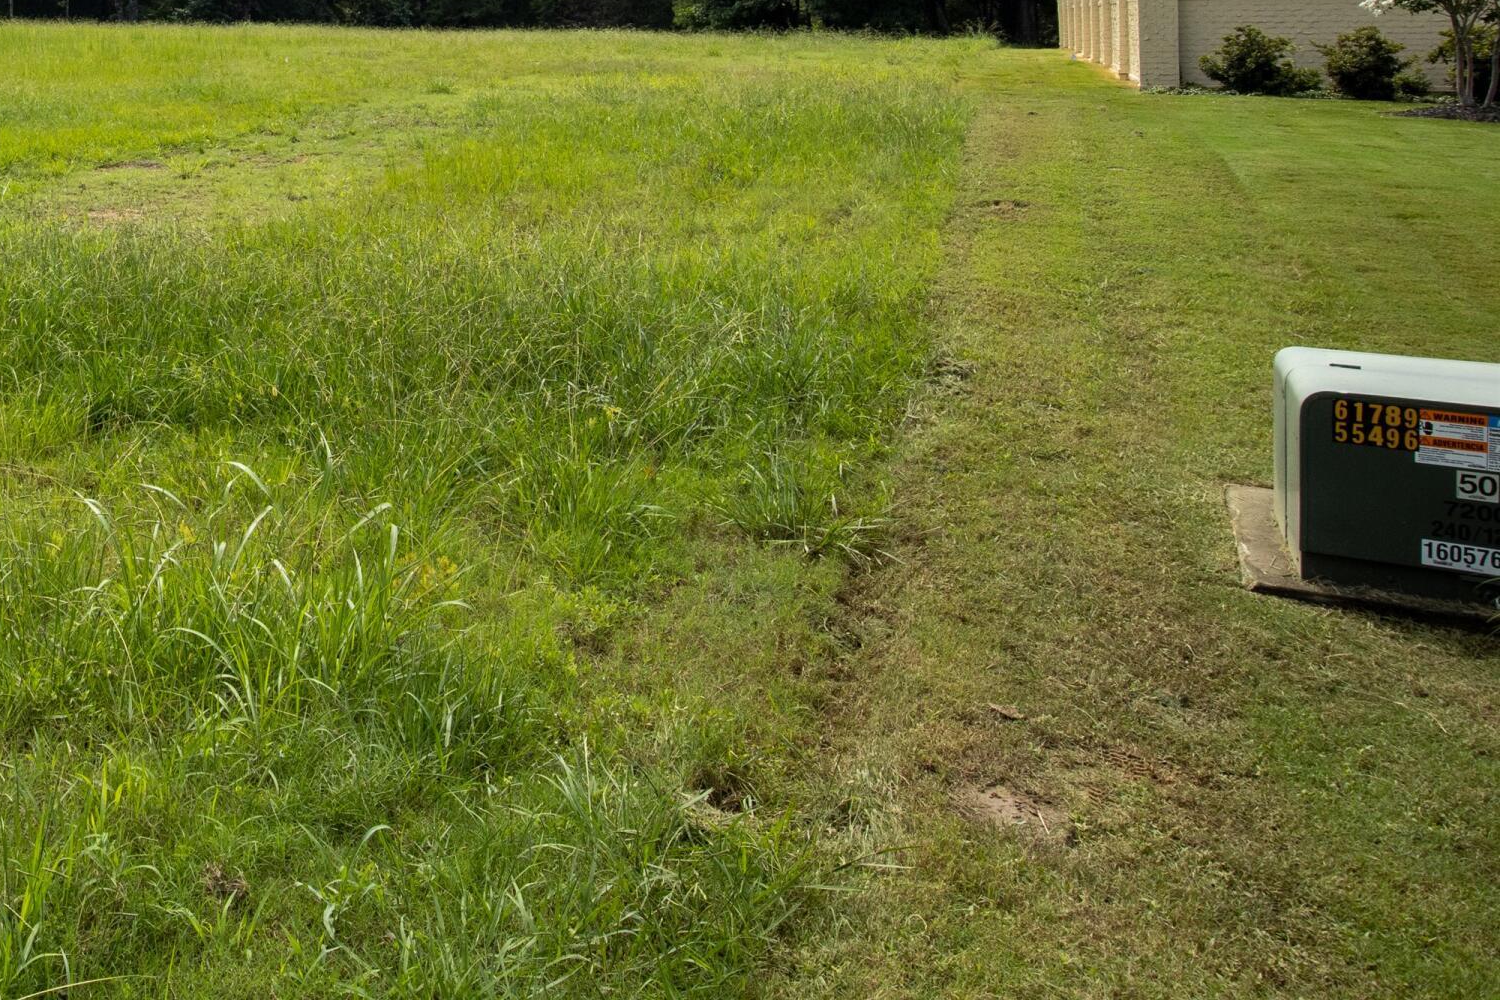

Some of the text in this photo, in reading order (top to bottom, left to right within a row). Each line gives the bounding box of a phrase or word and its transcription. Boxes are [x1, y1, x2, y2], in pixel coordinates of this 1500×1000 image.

[1334, 399, 1418, 429] 61789
[1432, 412, 1485, 427] WARNING
[1334, 421, 1418, 451] 55496
[1459, 473, 1498, 497] 50
